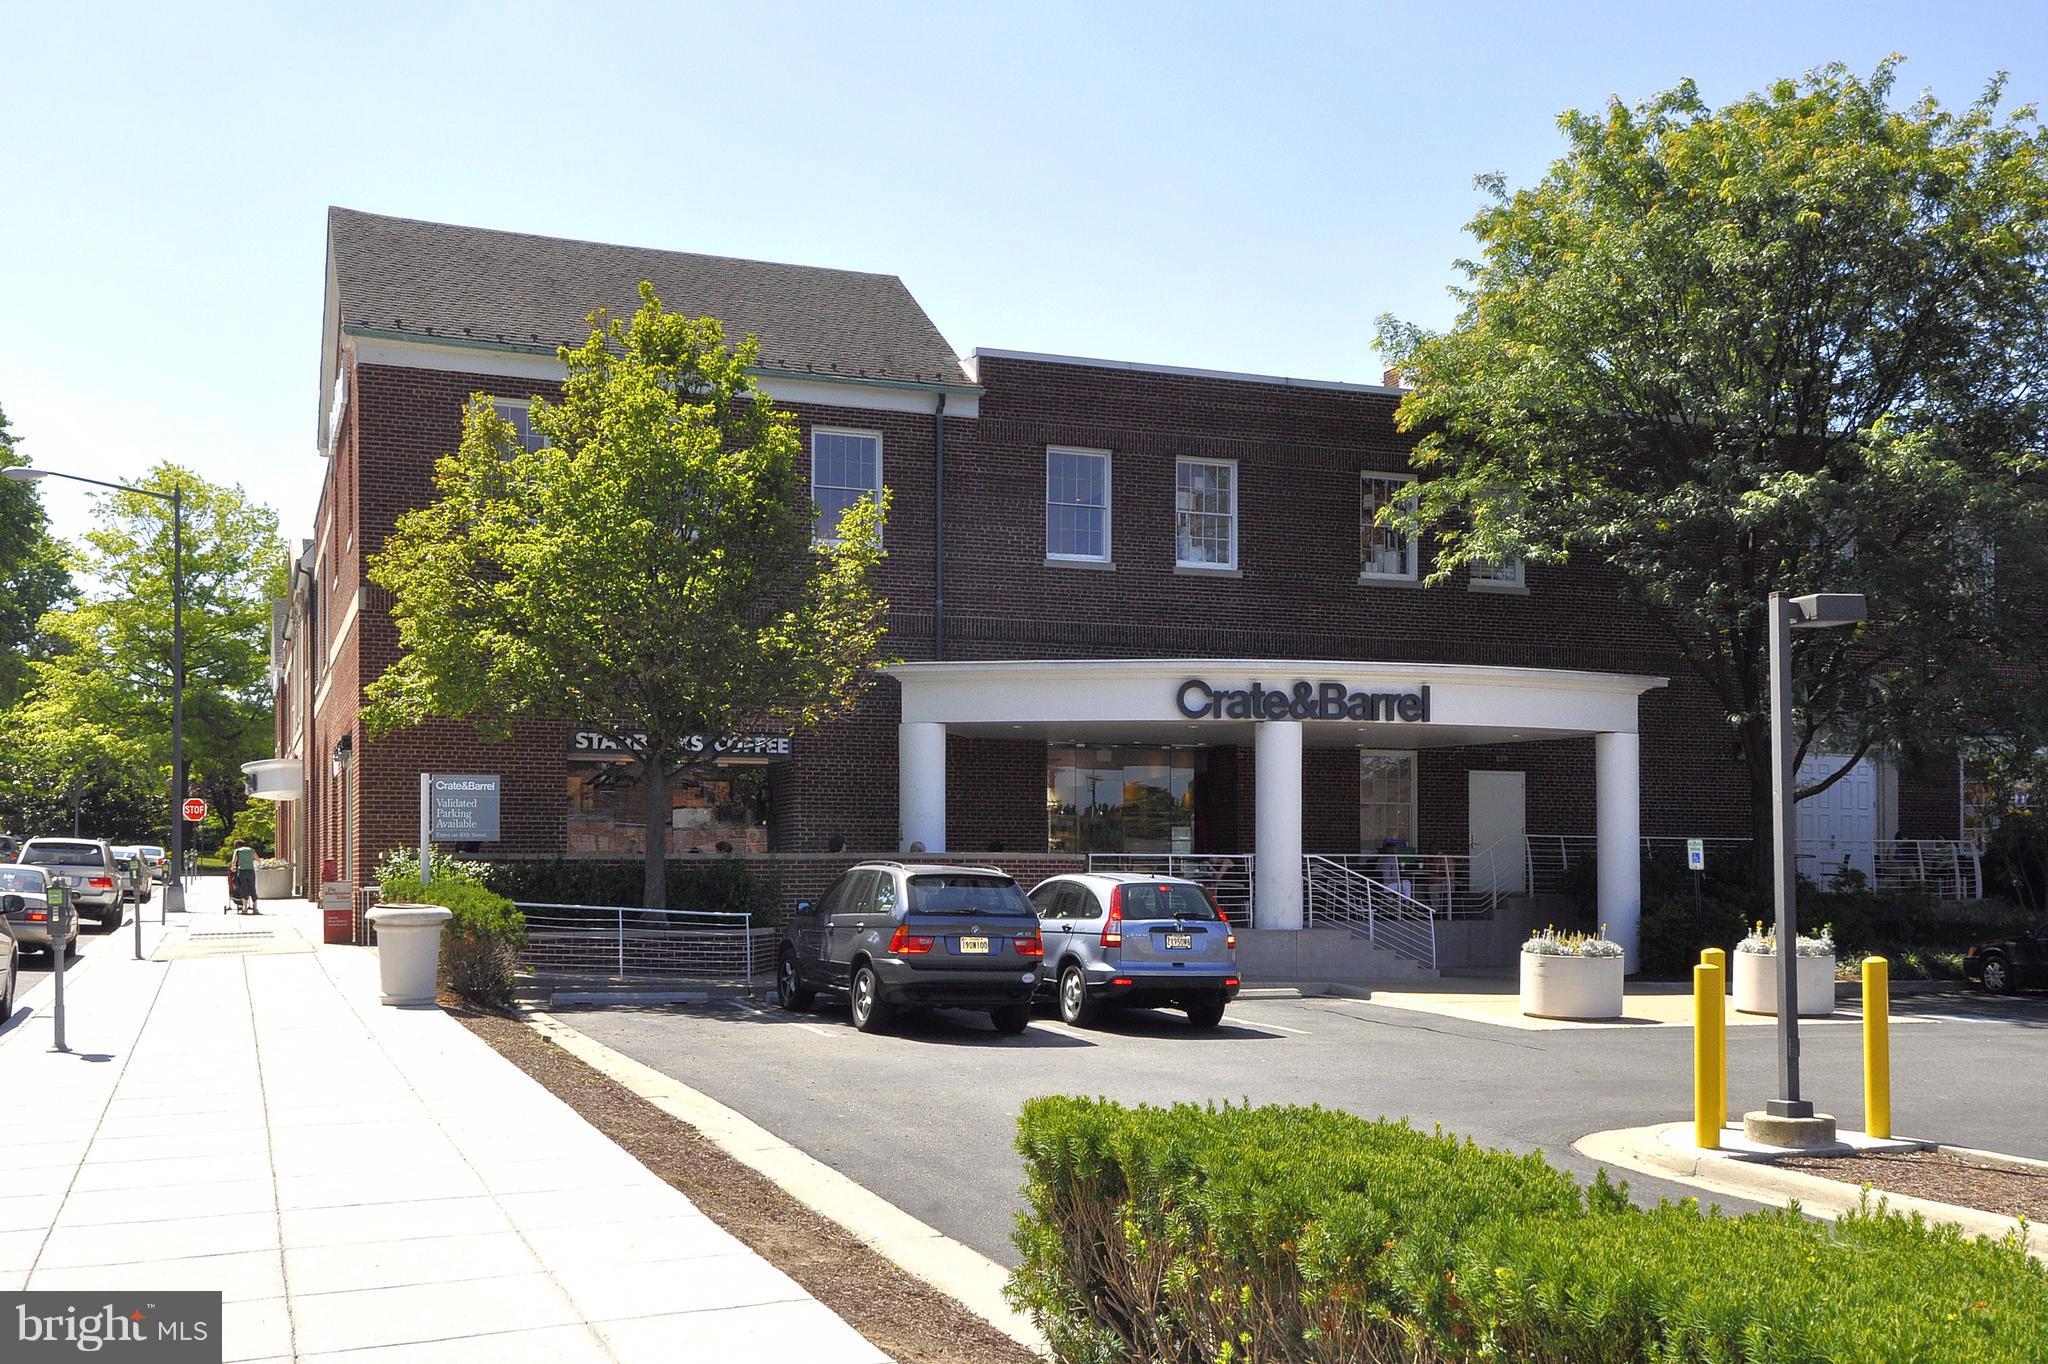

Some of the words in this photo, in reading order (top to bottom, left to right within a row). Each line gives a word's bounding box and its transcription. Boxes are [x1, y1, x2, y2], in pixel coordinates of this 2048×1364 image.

[1177, 679, 1431, 722] Crate&Barrel
[435, 780, 496, 791] Crate&Barrel
[436, 798, 477, 808] Validated
[185, 805, 205, 815] STOP
[436, 808, 473, 820] Parking
[436, 819, 477, 829] Available
